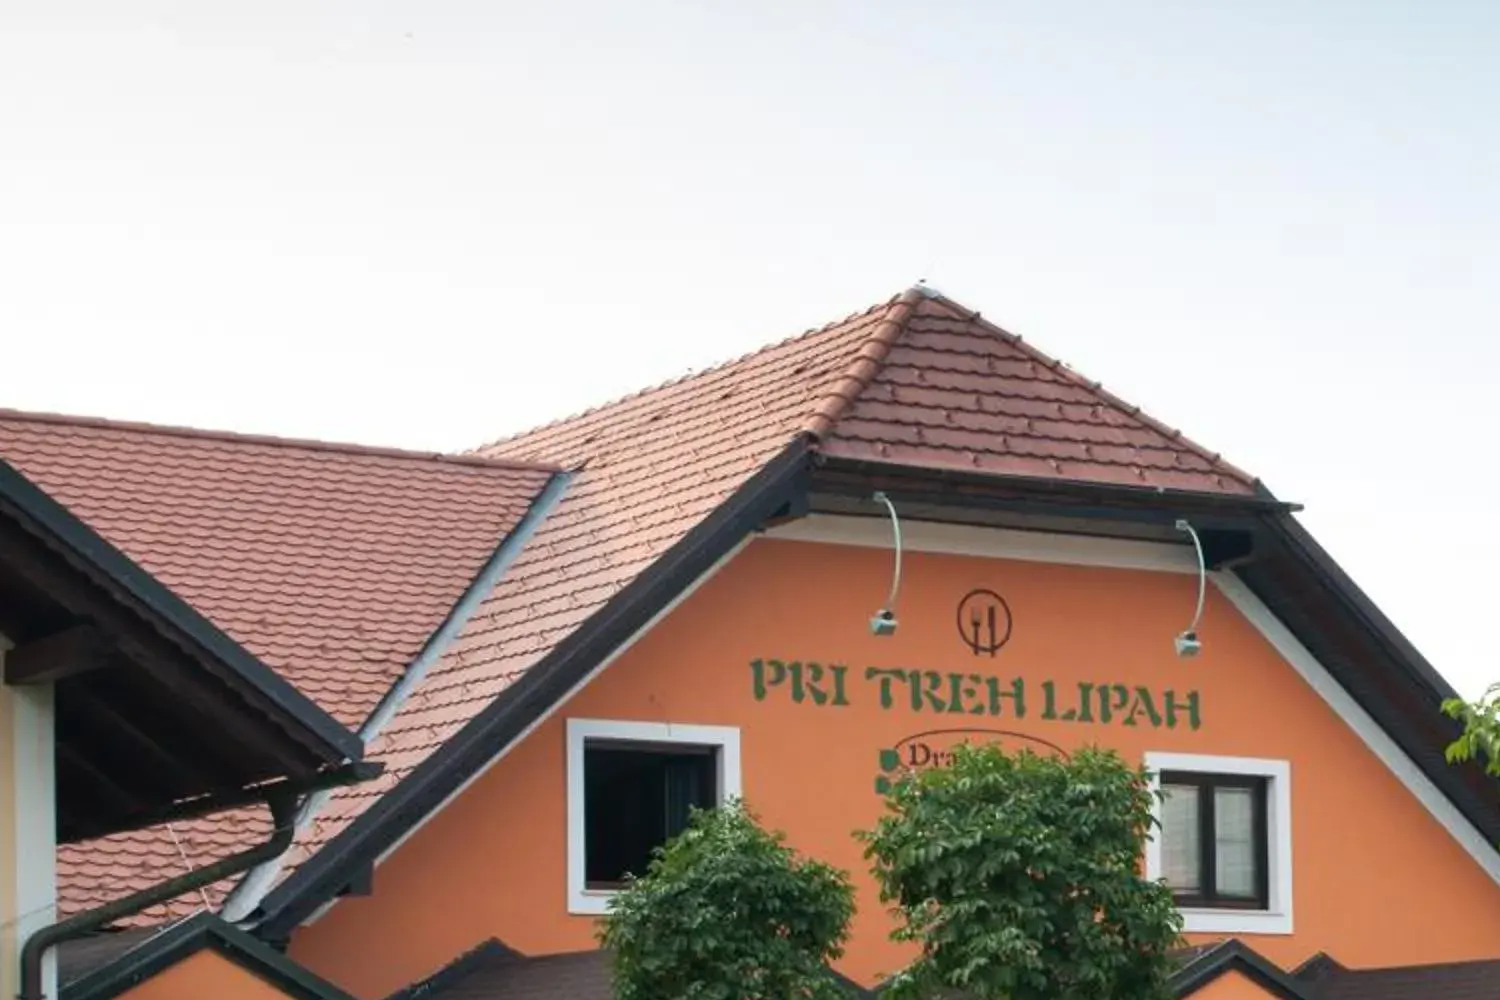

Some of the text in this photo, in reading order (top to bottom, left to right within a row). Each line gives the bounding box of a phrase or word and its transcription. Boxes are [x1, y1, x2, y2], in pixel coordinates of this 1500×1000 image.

[750, 658, 1201, 731] PRI TREH LIPAH
